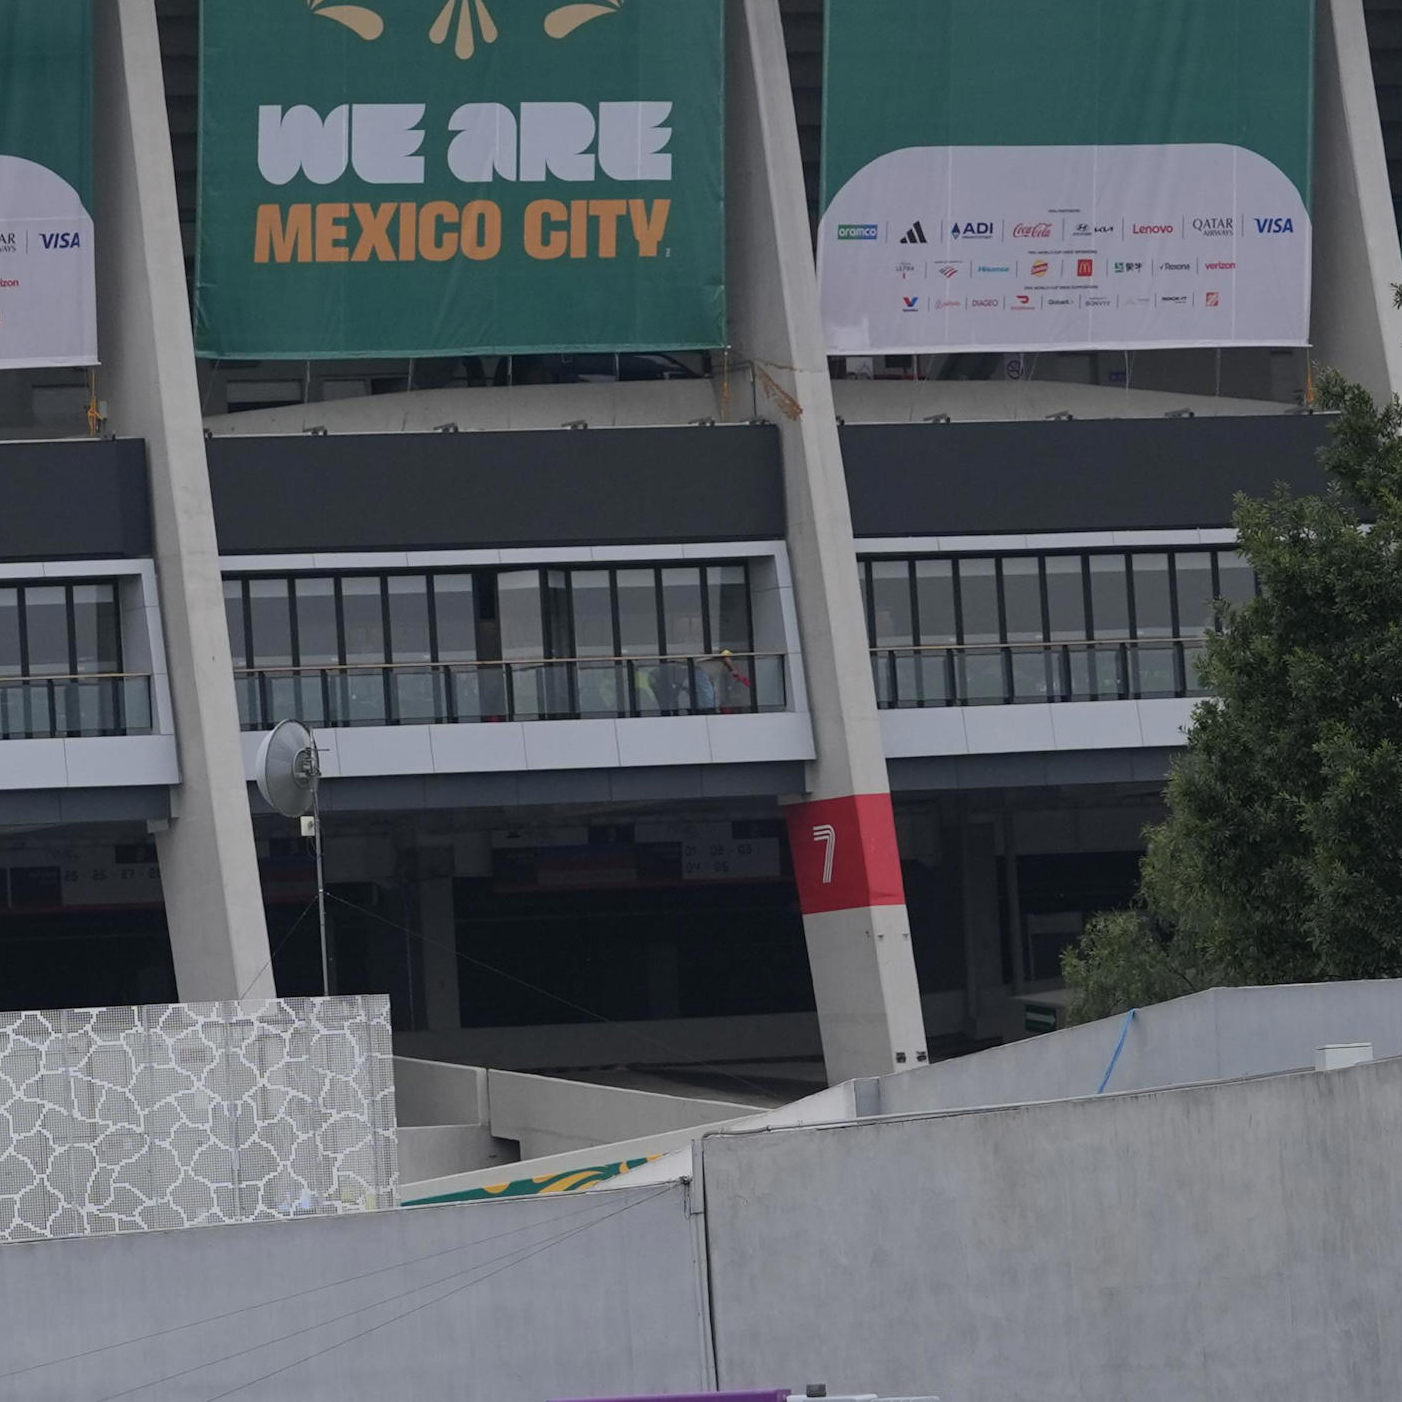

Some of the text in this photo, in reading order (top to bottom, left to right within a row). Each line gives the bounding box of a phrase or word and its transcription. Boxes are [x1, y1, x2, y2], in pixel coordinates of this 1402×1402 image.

[257, 101, 673, 186] WE ARE
[254, 199, 671, 264] MEXICO CITY
[838, 227, 877, 237] aramco
[963, 222, 994, 234] ADI
[1132, 224, 1174, 234] Lenovo
[1192, 218, 1234, 232] QATAR
[1254, 218, 1294, 234] VISA
[39, 232, 80, 249] VISA
[1205, 261, 1236, 271] verizon
[812, 823, 837, 884] 7
